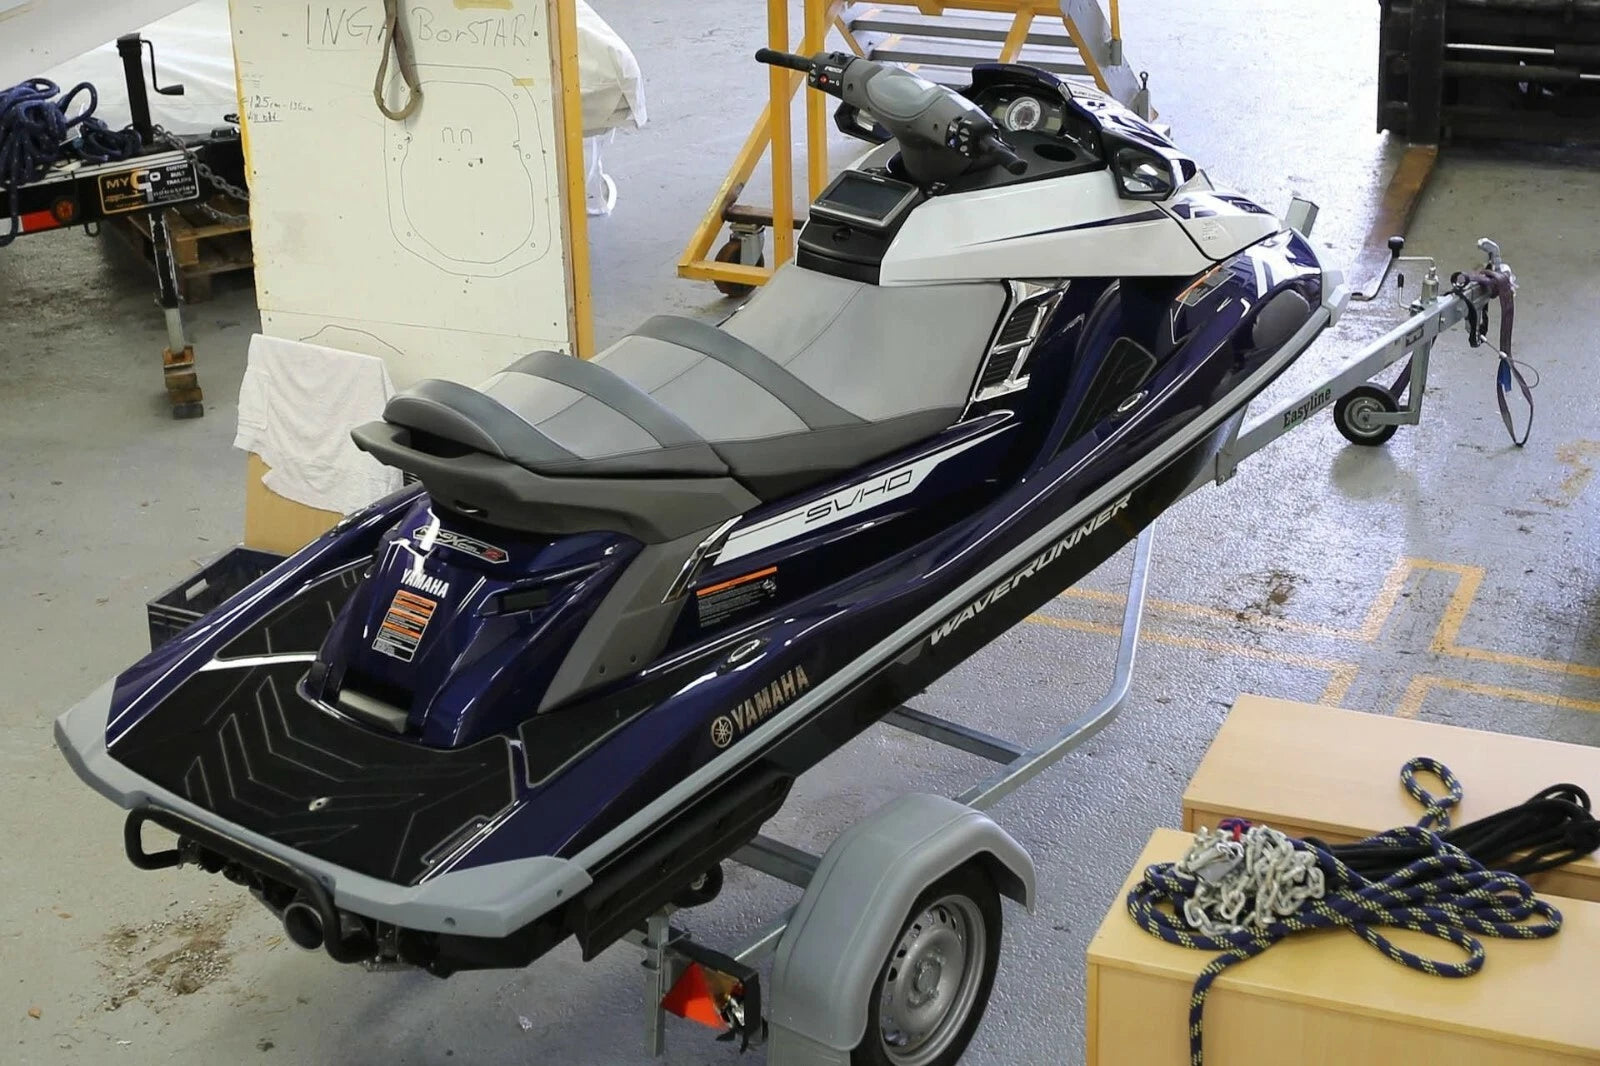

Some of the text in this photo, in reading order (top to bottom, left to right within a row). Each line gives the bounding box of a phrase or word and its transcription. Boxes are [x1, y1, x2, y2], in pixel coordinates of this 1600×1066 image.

[1283, 388, 1331, 428] Easyline
[805, 470, 912, 524] SVHO
[400, 568, 450, 599] YAMAHA
[931, 492, 1133, 646] WAVERUNNER
[731, 664, 810, 734] YAMAHA
